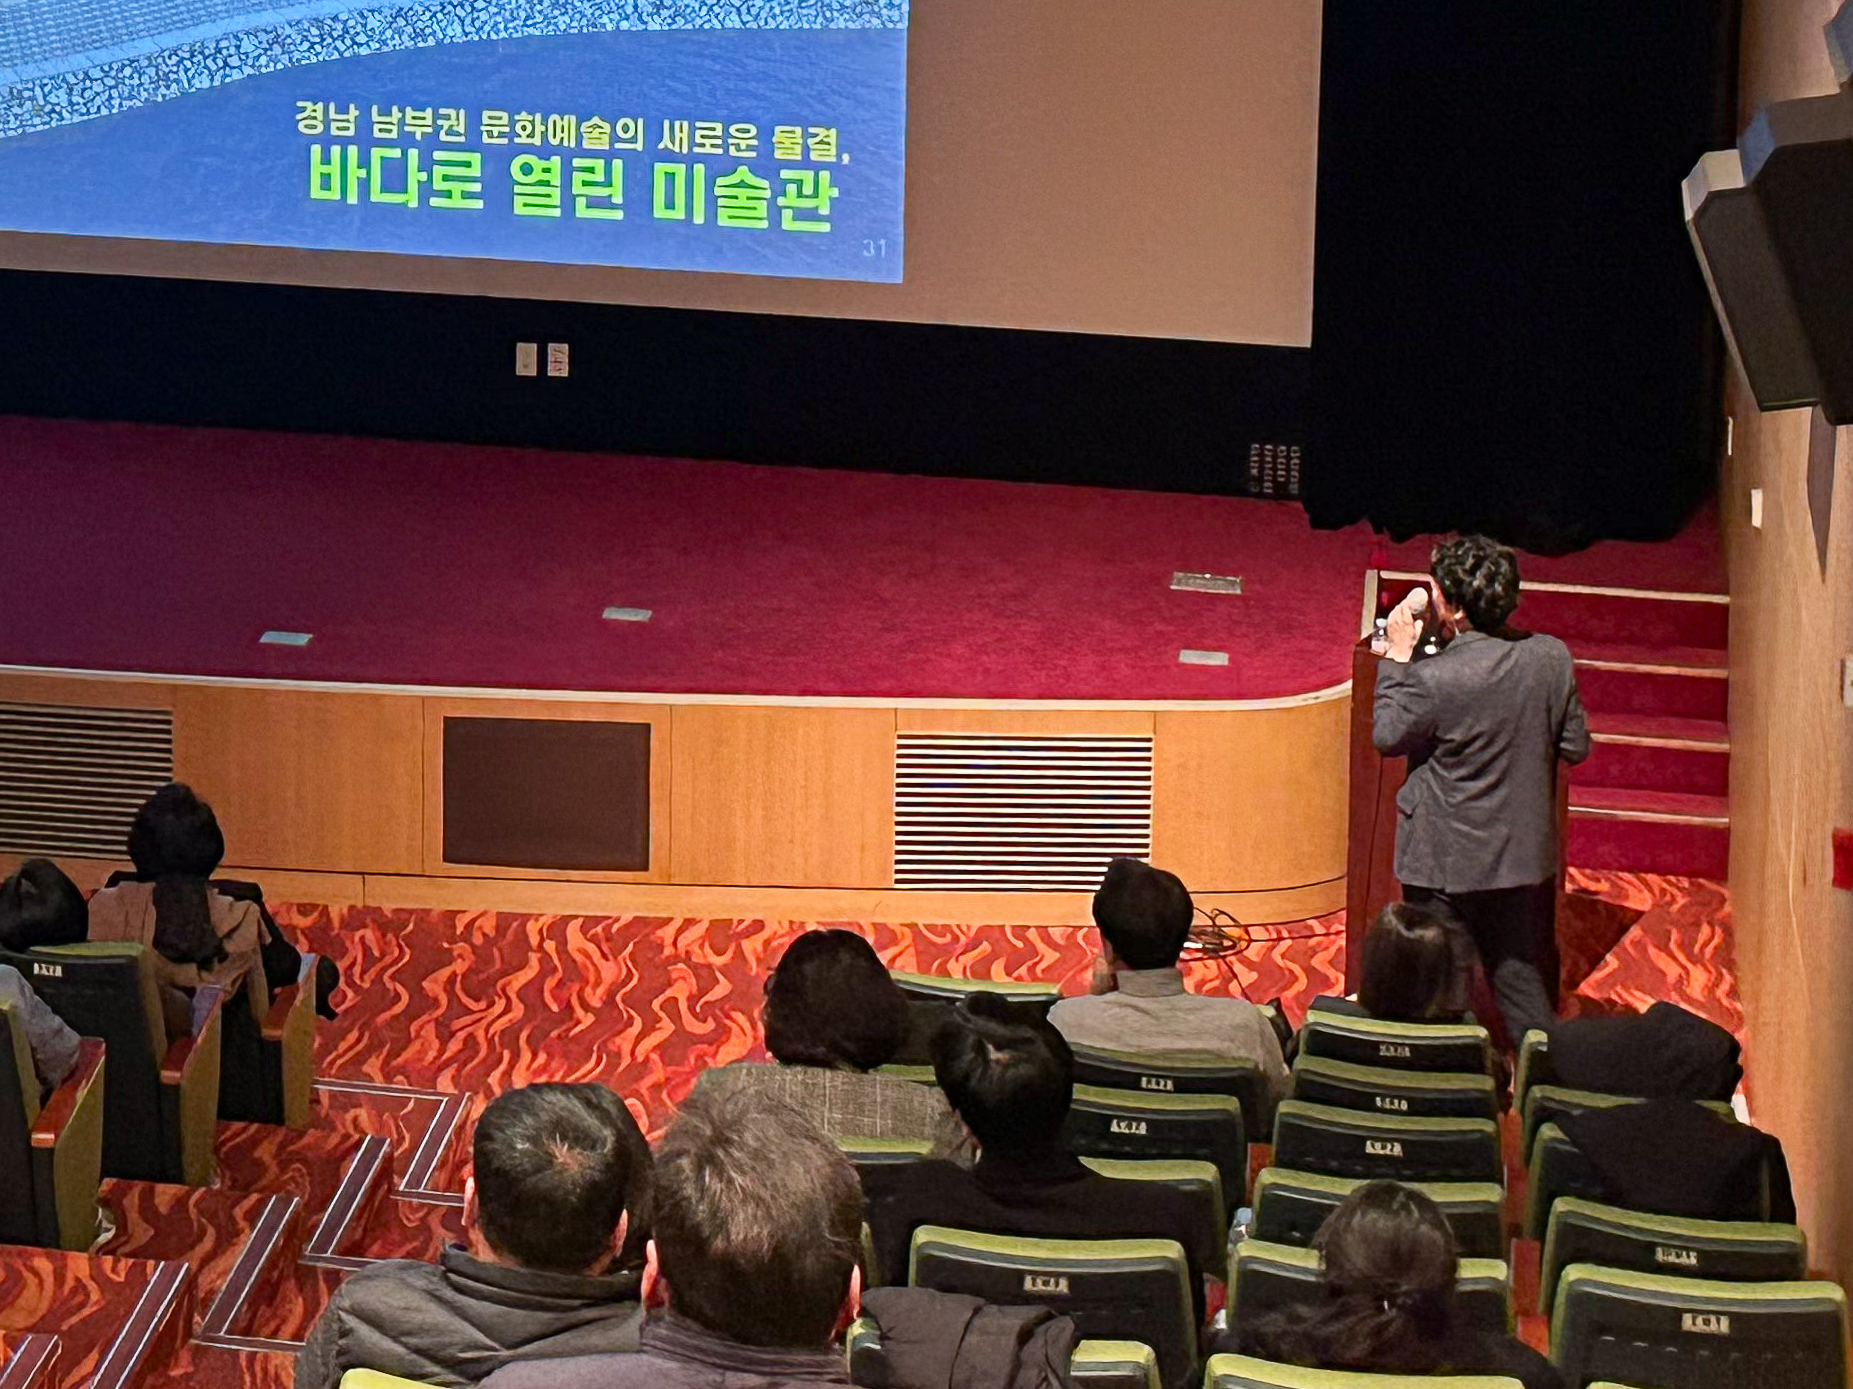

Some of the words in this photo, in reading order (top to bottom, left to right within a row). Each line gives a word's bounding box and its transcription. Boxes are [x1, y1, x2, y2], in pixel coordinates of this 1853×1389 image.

[295, 100, 359, 137] 경남
[371, 104, 466, 143] 남부권
[480, 110, 644, 151] 문화예술의
[657, 119, 759, 158] 새로운
[310, 143, 485, 210] 바다로
[510, 153, 624, 220] 열린
[653, 161, 839, 233] 미술관
